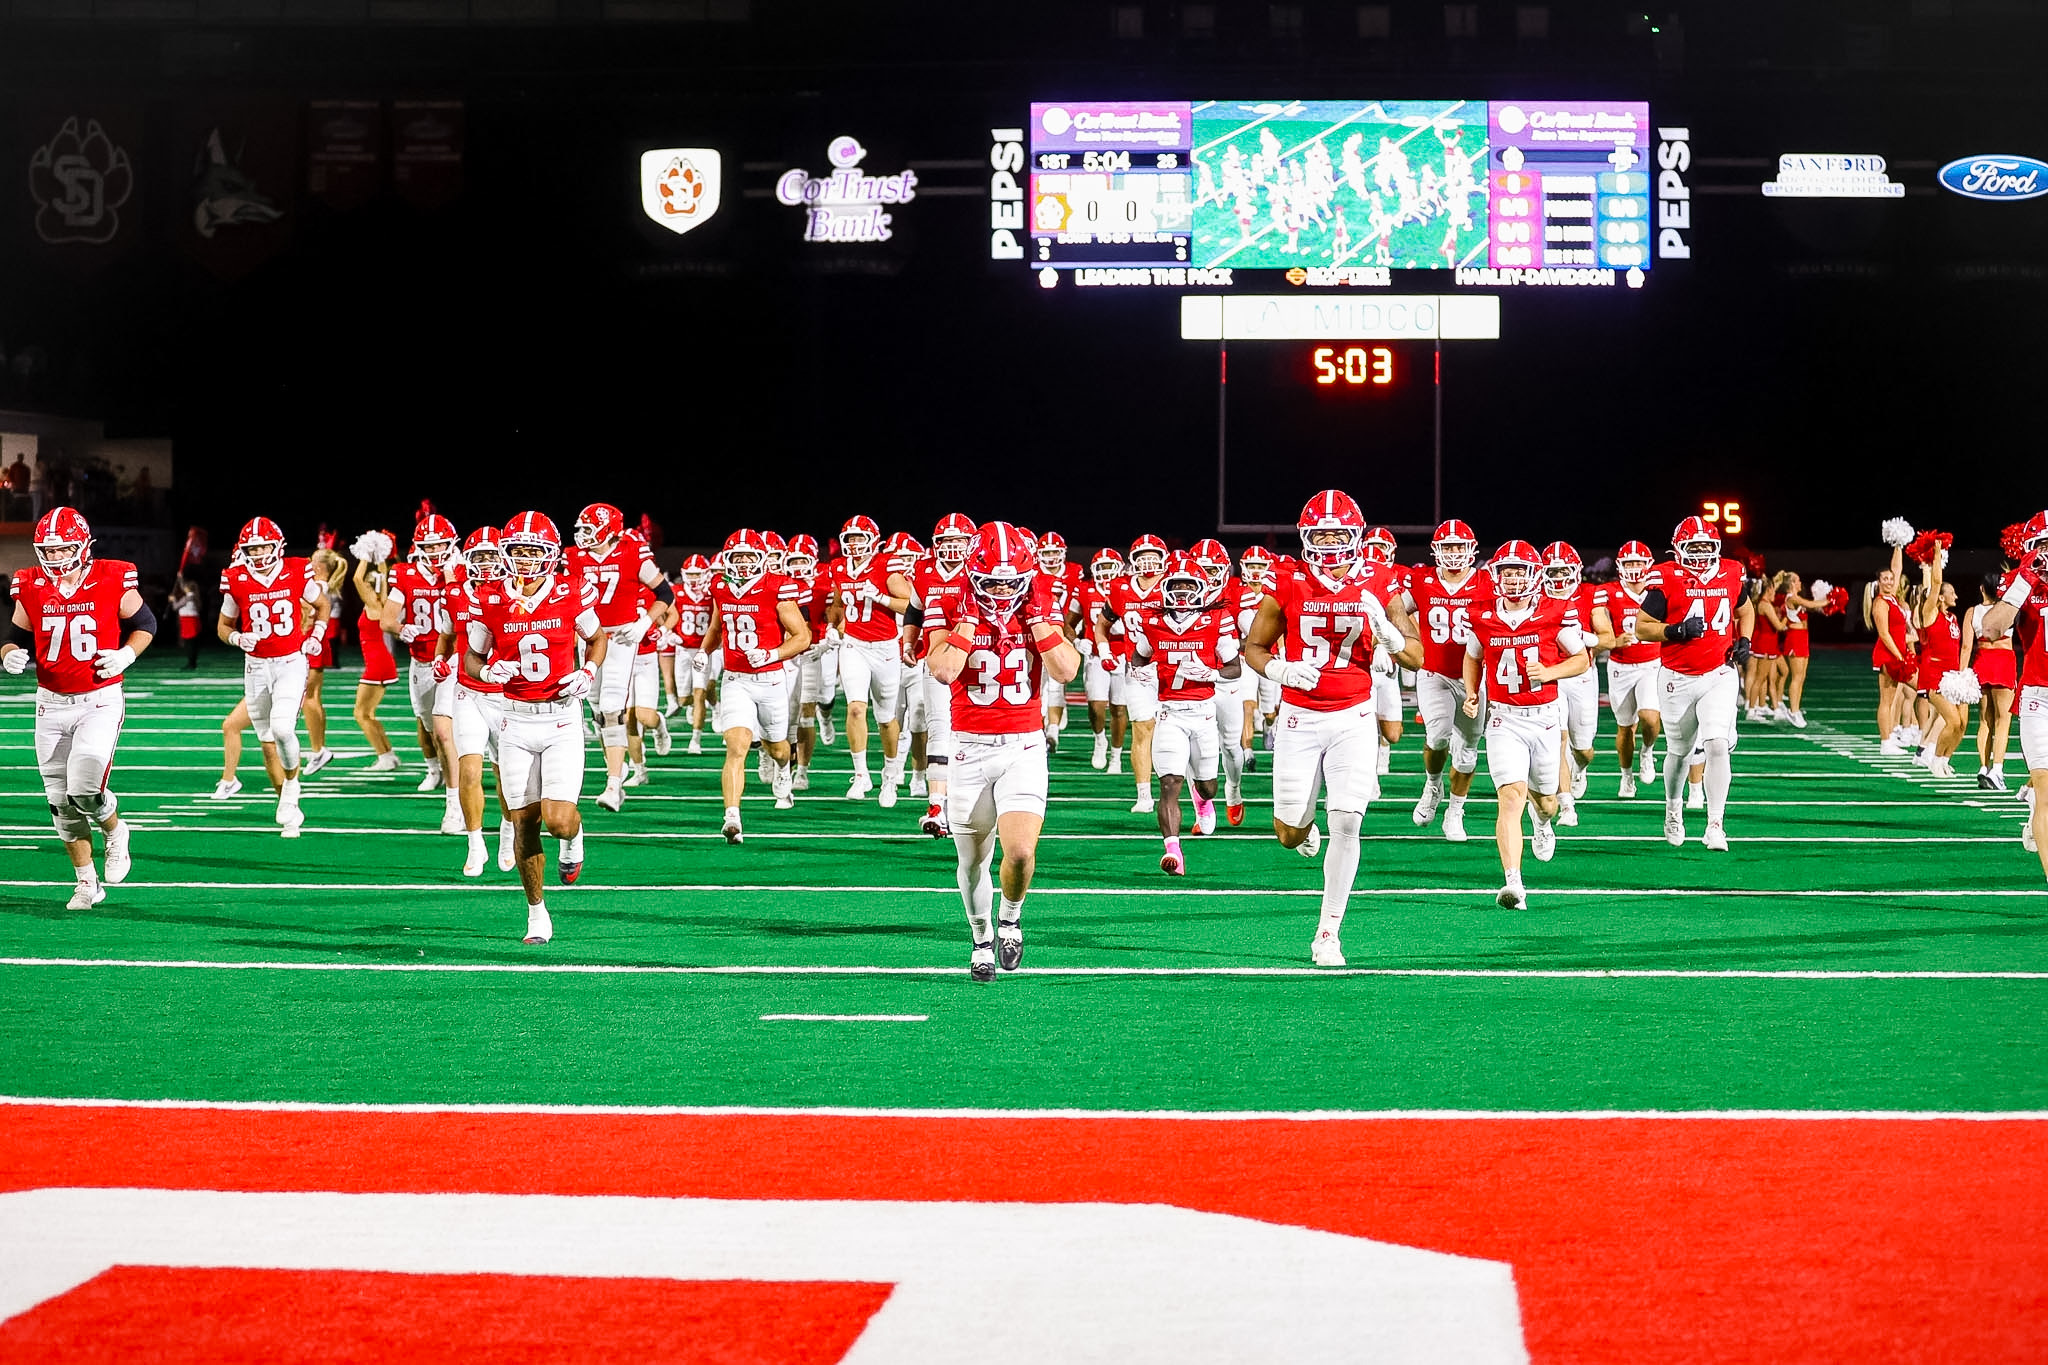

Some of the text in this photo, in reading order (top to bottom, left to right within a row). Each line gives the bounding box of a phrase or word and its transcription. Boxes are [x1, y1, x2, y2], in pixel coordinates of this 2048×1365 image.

[1039, 154, 1071, 170] 1ST
[1082, 151, 1132, 172] 5:04
[1781, 157, 1884, 172] SANFORD
[779, 171, 915, 203] CorTrust
[1962, 160, 2038, 193] Ford
[992, 128, 1024, 260] PEPSI
[1658, 127, 1691, 259] PEPSI
[807, 208, 891, 240] Bank
[1151, 268, 1187, 286] THE
[1187, 268, 1233, 286] PACK
[1455, 267, 1615, 286] HARLEY-DAVIDSON
[1313, 302, 1435, 333] MIDCO
[1313, 347, 1393, 385] 5:03
[1360, 565, 1375, 578] C
[555, 583, 571, 596] C
[1429, 596, 1449, 605] SOUTH
[1685, 587, 1728, 597] SOUTH DAKOTA
[43, 601, 95, 614] SOUTH DAKOTA
[249, 599, 294, 640] 83
[456, 611, 470, 621] SOUT
[721, 604, 759, 613] SOUTH DAKOTA
[840, 590, 873, 623] 87
[1200, 615, 1212, 625] C
[1303, 602, 1331, 613] SOUTH
[1682, 597, 1731, 639] 44
[503, 618, 562, 633] SOUTH DAKOTA
[681, 610, 710, 636] 89
[722, 613, 759, 651] 18
[41, 614, 98, 662] 76
[1158, 641, 1204, 650] SOUTH DAKOTA
[1299, 615, 1364, 669] 57
[1489, 634, 1540, 647] SOUTH DAKOTA
[518, 633, 552, 682] 6
[1167, 651, 1193, 690] 7
[1495, 645, 1543, 694] 41
[967, 648, 1035, 706] 33
